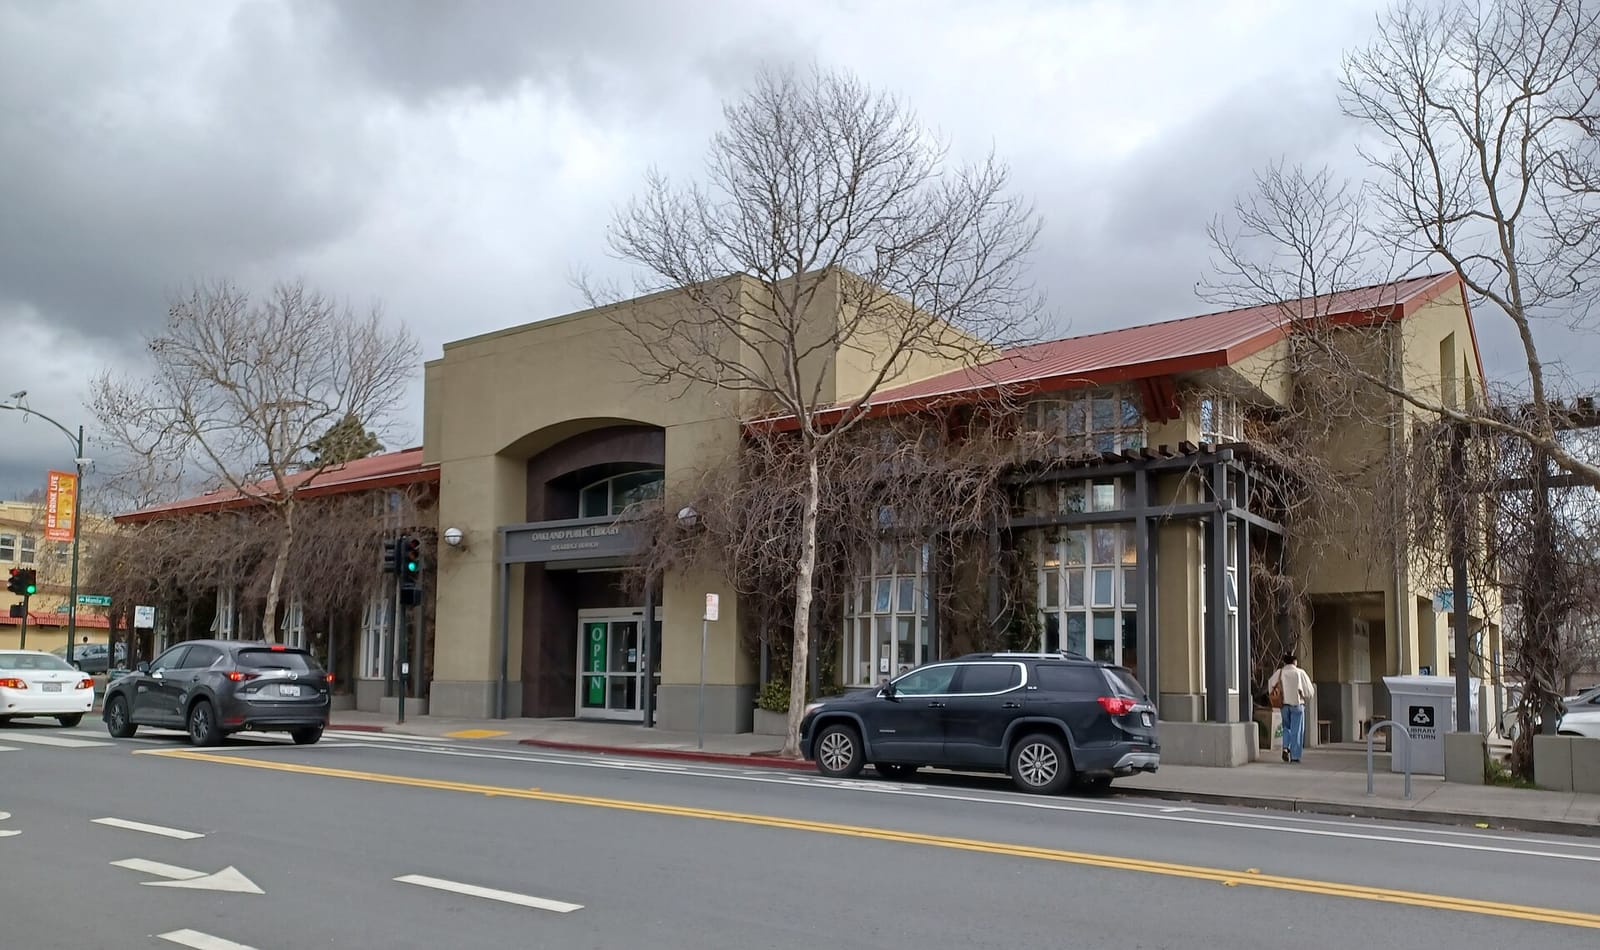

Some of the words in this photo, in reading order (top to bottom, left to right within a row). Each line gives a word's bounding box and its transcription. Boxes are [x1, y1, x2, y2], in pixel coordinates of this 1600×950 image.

[532, 531, 564, 541] OAKLAND
[565, 529, 590, 538] PUBLIC
[590, 527, 619, 536] LIBRARY
[592, 628, 603, 689] OPEN
